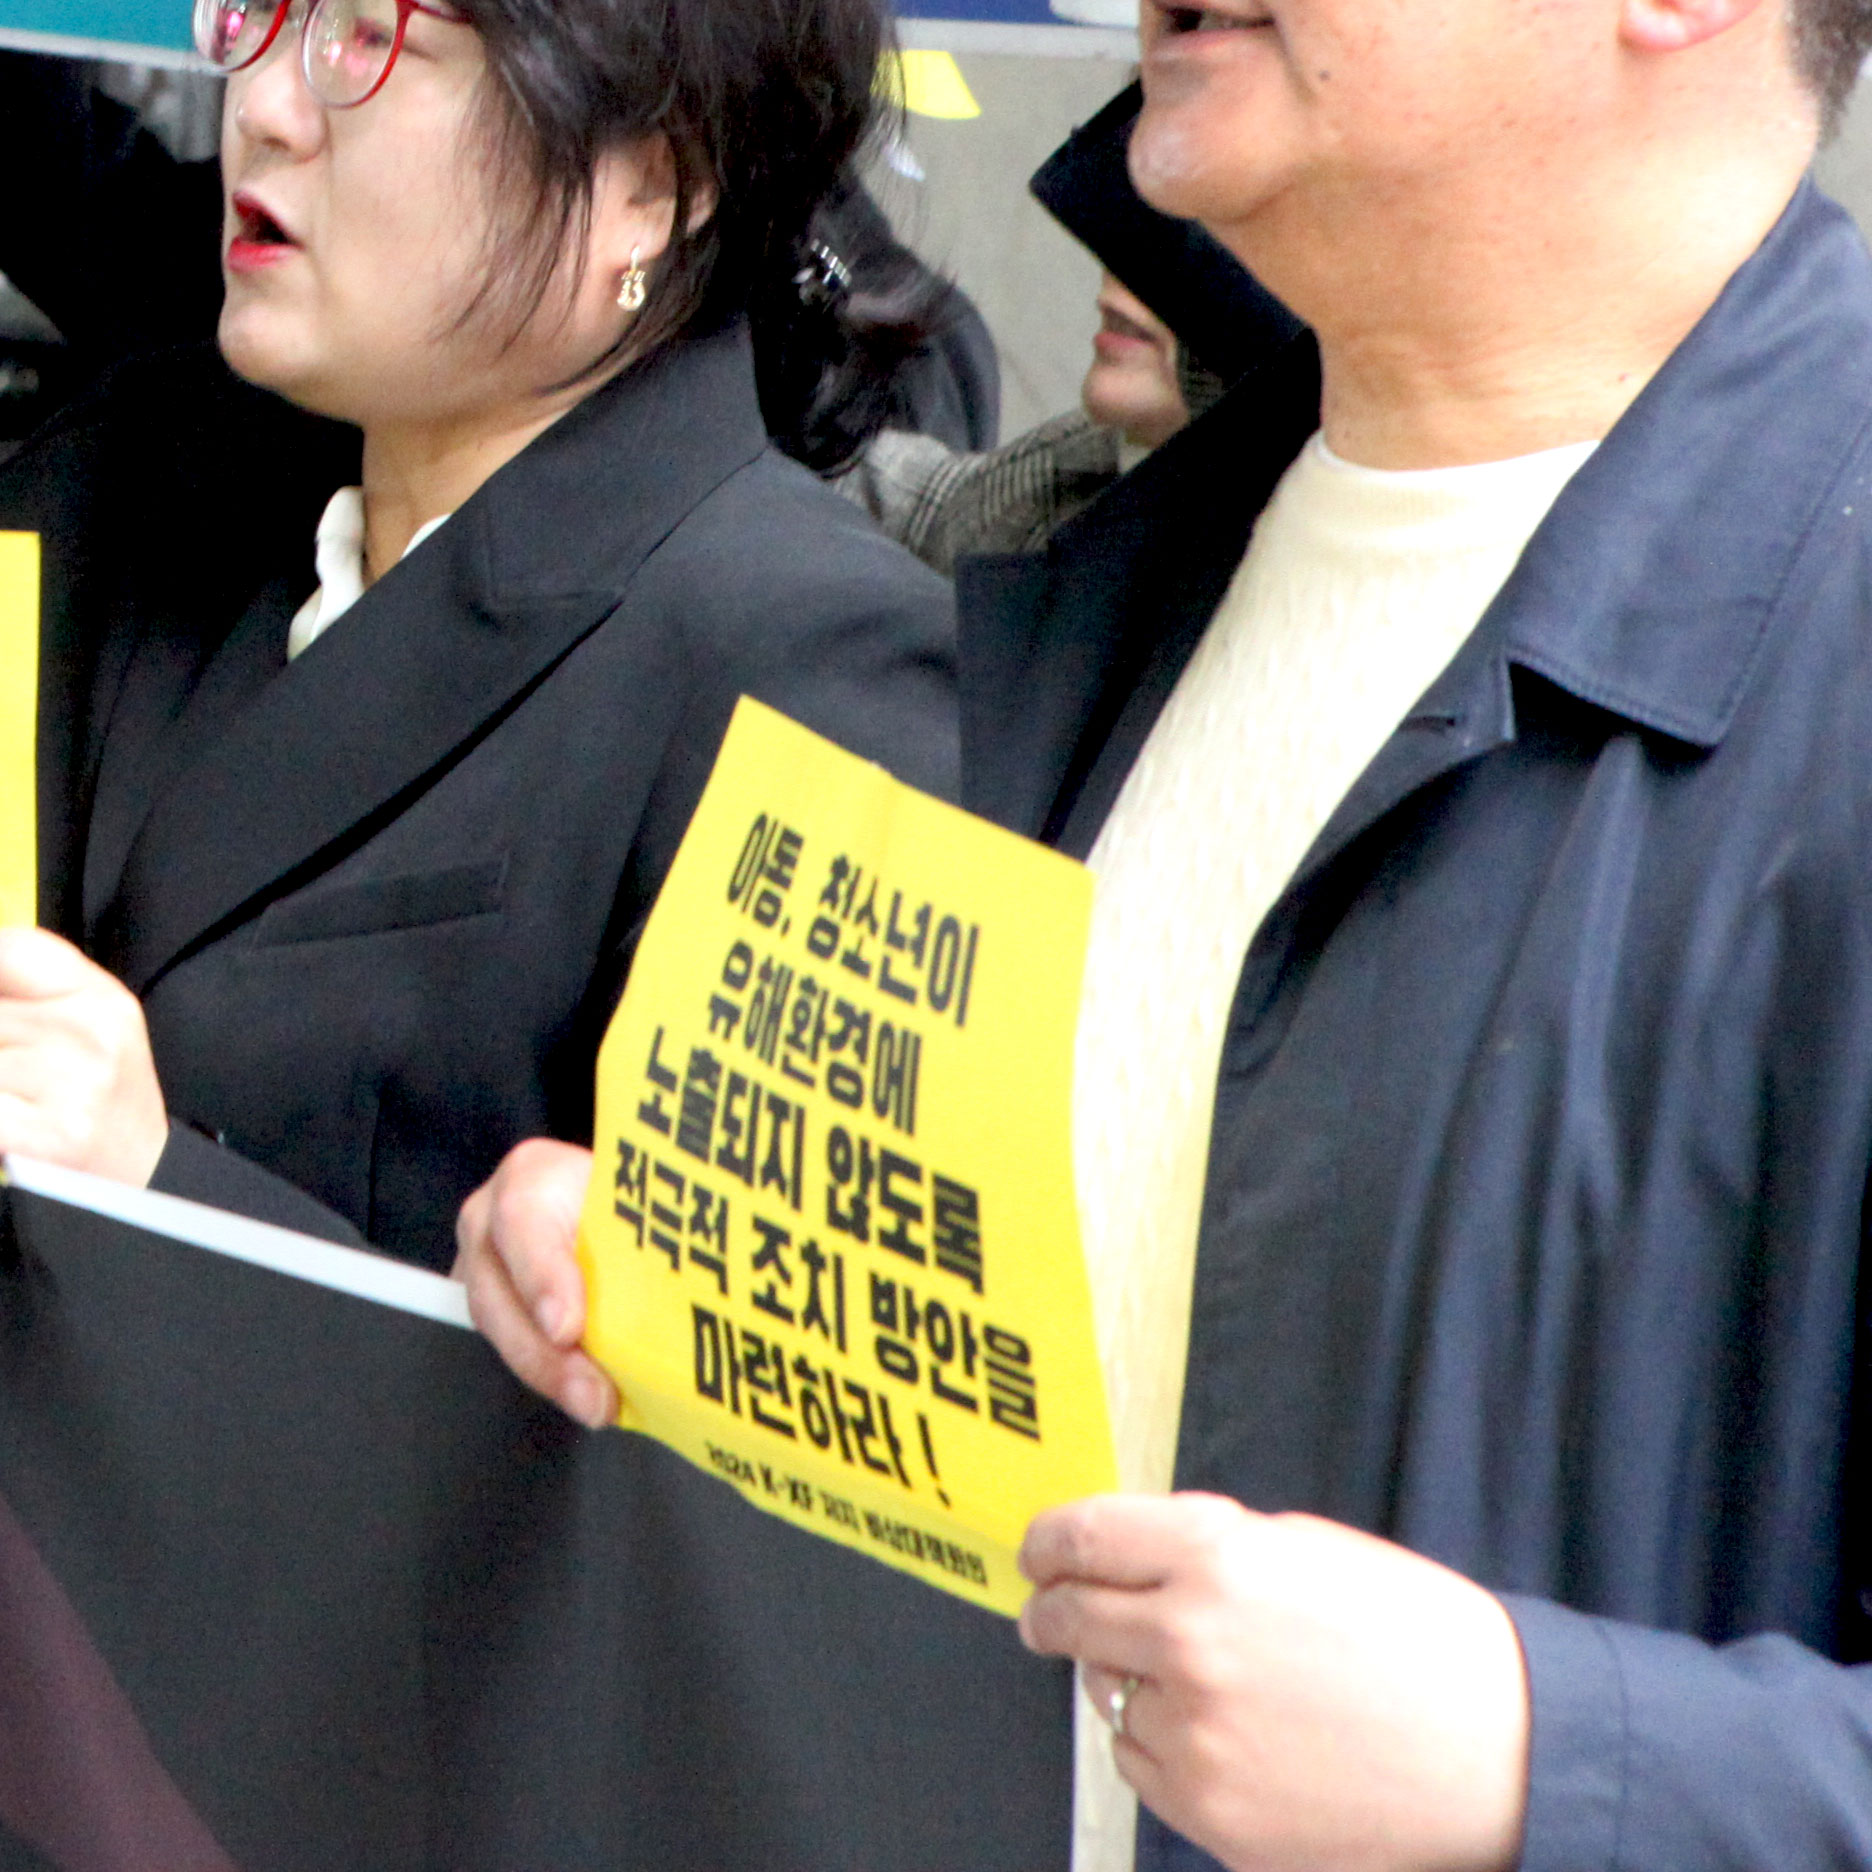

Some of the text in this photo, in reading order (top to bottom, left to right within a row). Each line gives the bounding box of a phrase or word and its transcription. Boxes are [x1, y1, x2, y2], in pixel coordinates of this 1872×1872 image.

[708, 939, 922, 1138] 유해환경에
[807, 854, 980, 1029] 청소년이
[637, 1024, 984, 1298] 노출되지 않도록
[615, 1137, 1041, 1443] 적극적 조치 방안을
[692, 1302, 911, 1490] 마련하라
